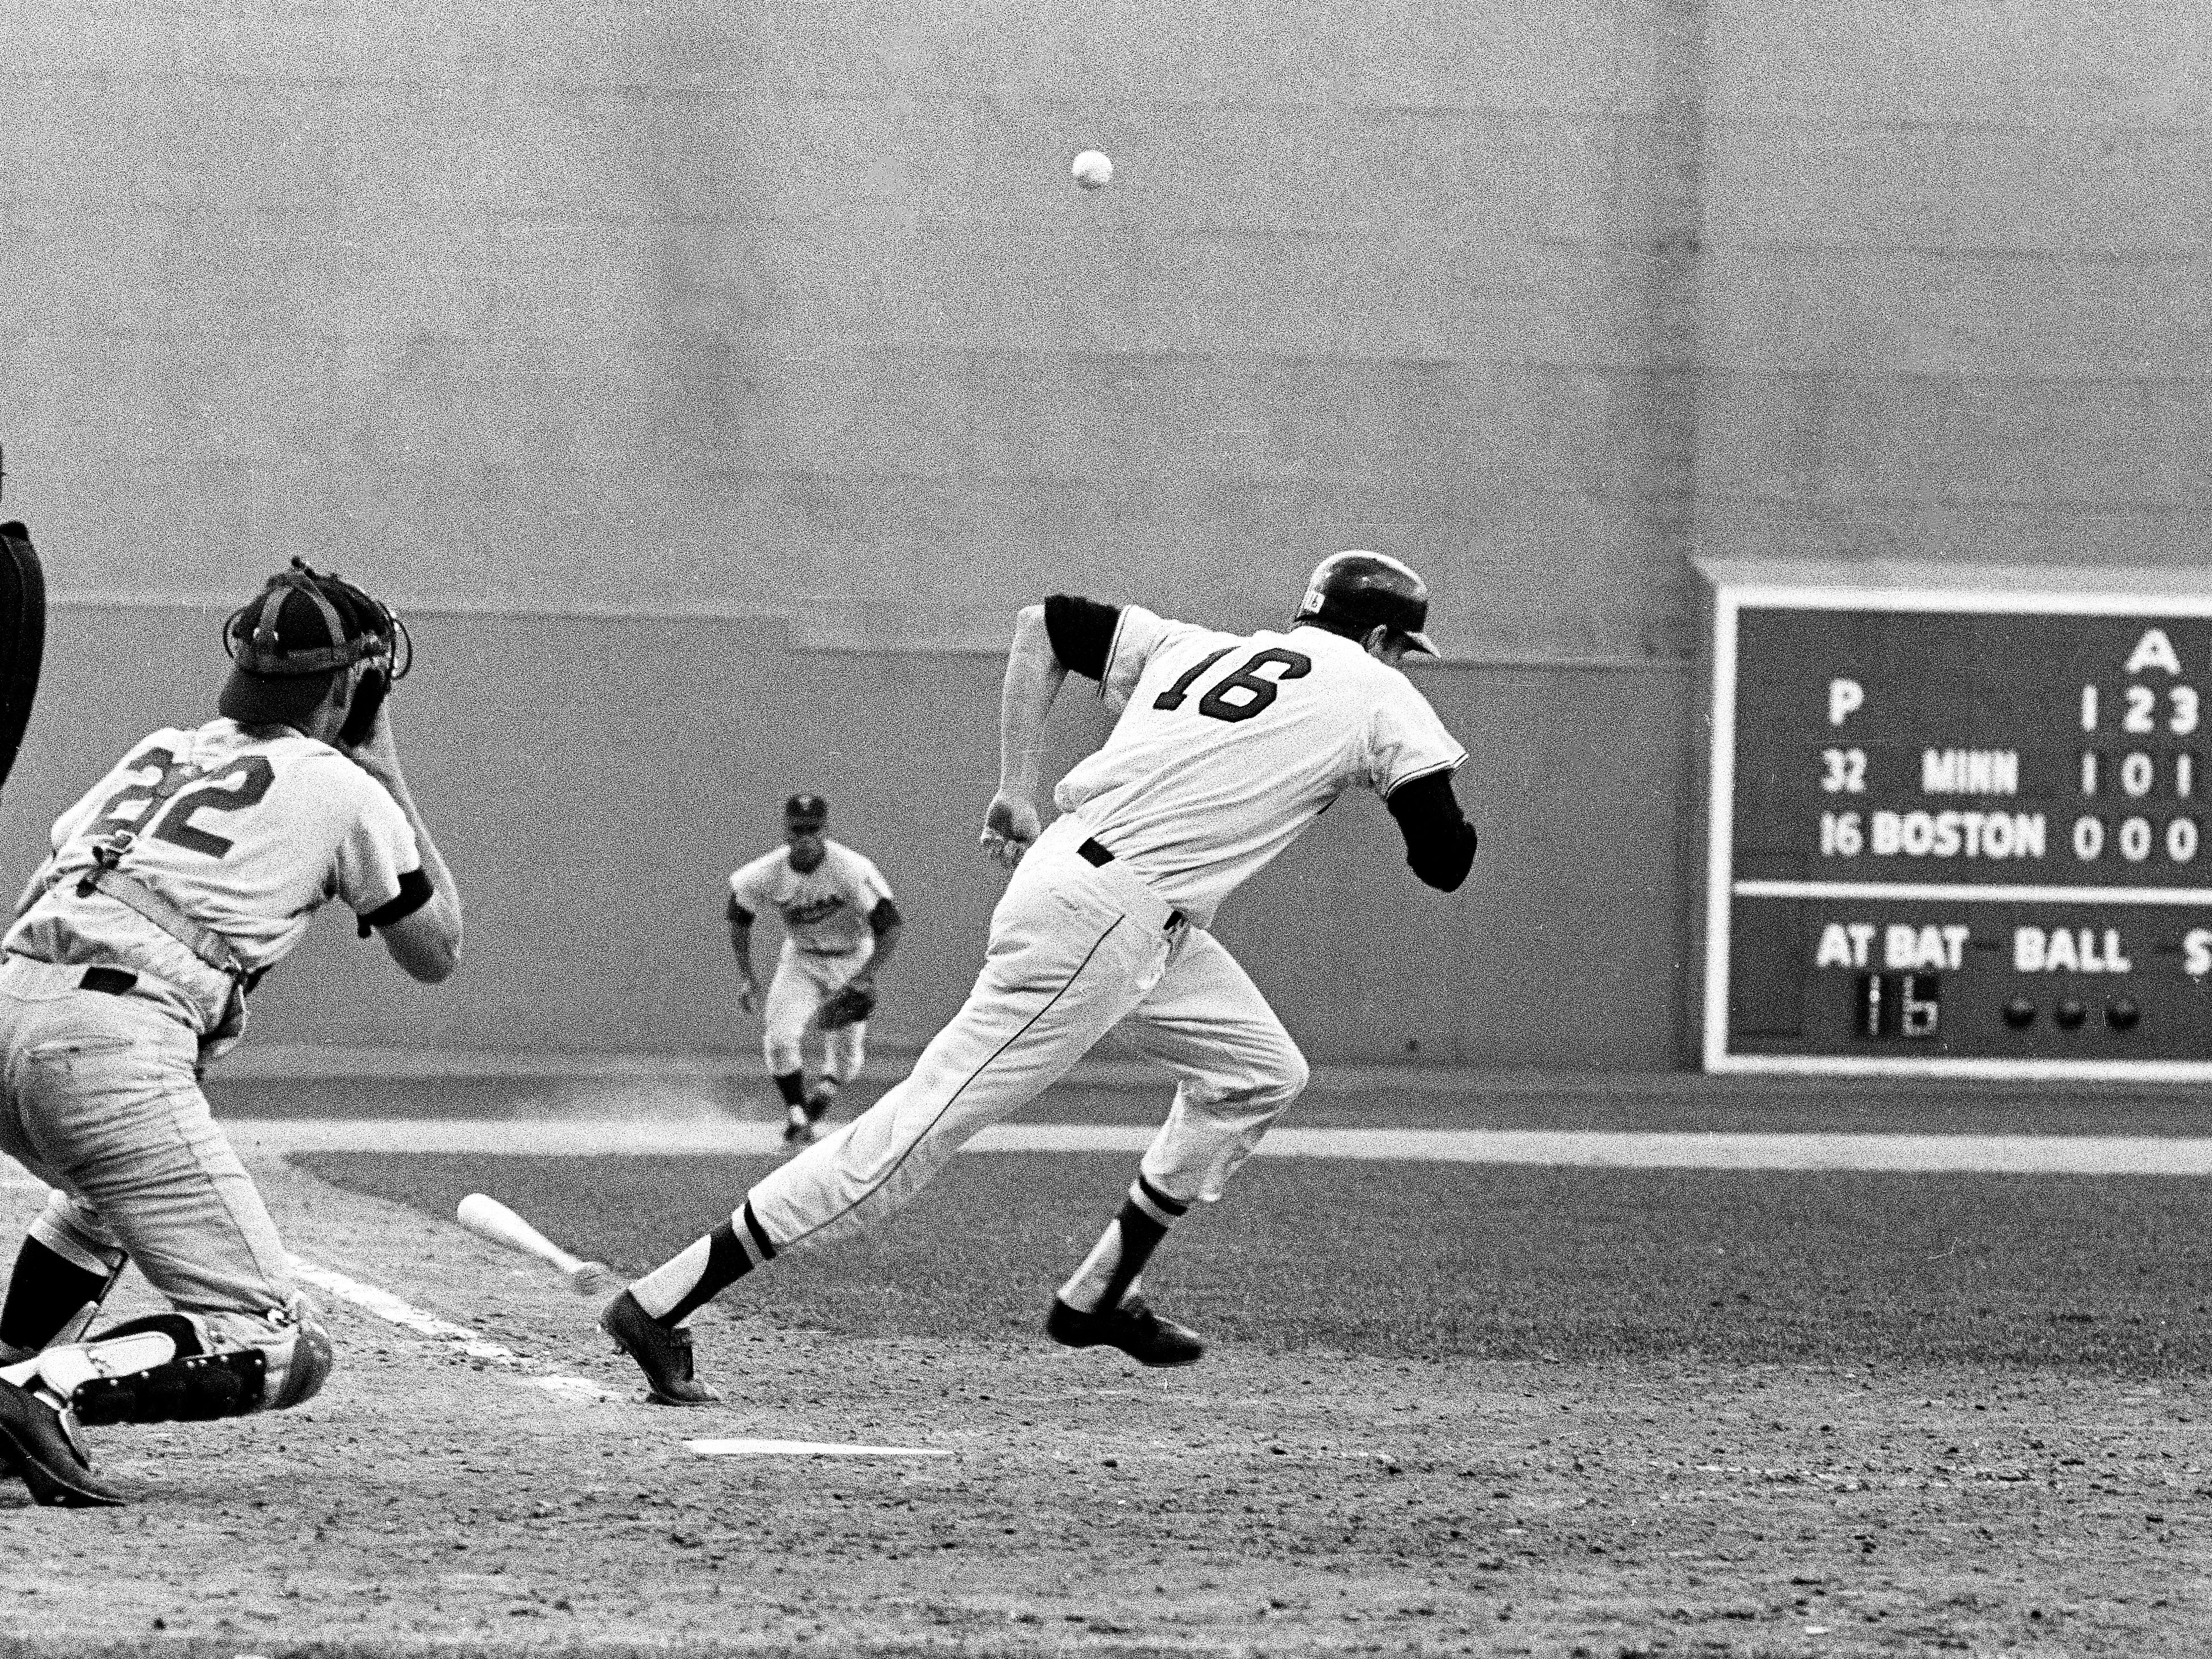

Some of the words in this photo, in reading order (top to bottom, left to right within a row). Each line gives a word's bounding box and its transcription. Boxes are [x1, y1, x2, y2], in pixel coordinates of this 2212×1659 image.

[2126, 628, 2180, 674] A
[1153, 646, 1311, 723] 16
[1829, 678, 1864, 726] P
[2081, 684, 2097, 731] 1
[2124, 685, 2155, 733] 2
[2169, 685, 2199, 735] 3
[1821, 748, 1867, 793] 32
[1922, 748, 2018, 794] MINN
[2082, 752, 2096, 795] 1
[2121, 752, 2153, 796] 0
[2177, 754, 2191, 796] 1
[82, 747, 275, 859] 22
[1820, 812, 1863, 856] 16
[1871, 811, 2046, 858] BOSTON
[2073, 816, 2104, 861] 0
[2119, 817, 2151, 861] 0
[2166, 818, 2198, 862] 0
[1816, 924, 1876, 967] AT
[1885, 925, 1969, 970] BAT
[2014, 926, 2132, 973] BALL
[1868, 974, 1938, 1035] 16
